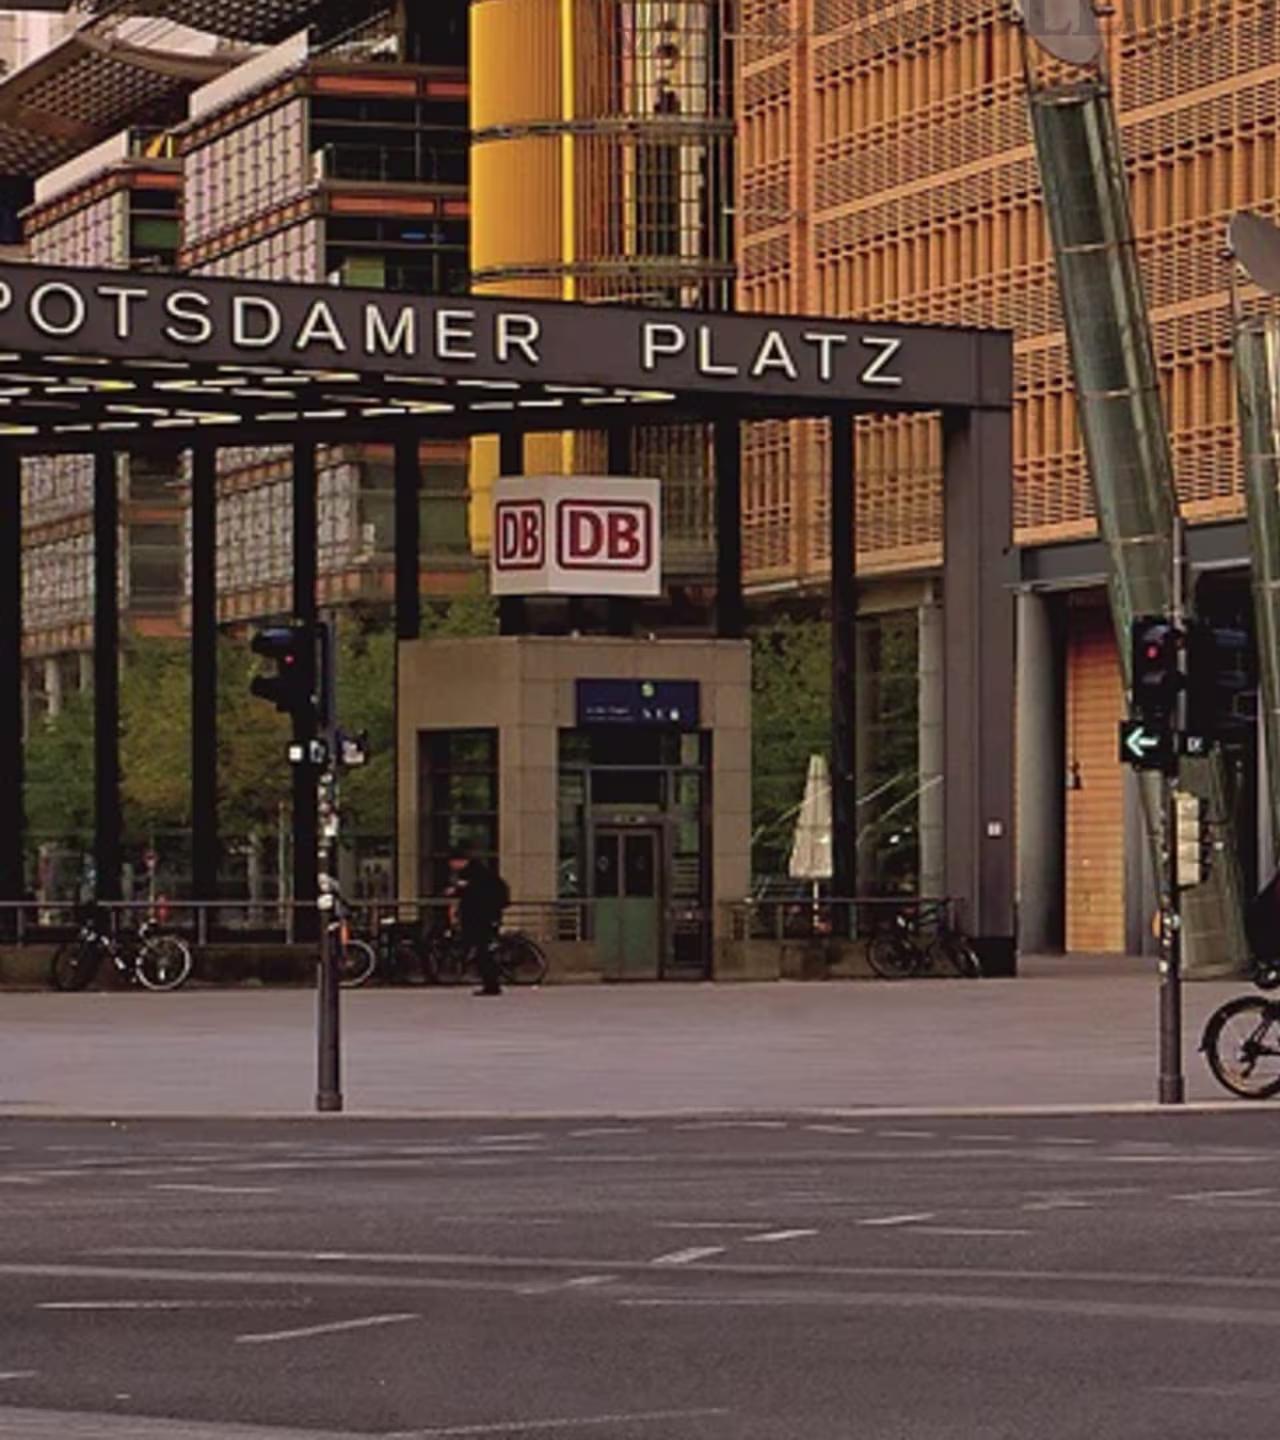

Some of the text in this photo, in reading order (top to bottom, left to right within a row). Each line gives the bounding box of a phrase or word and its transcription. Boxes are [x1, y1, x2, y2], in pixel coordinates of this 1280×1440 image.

[0, 281, 904, 385] OTSDAMER PLATZ
[502, 511, 539, 559] DB
[569, 510, 640, 560] DB
